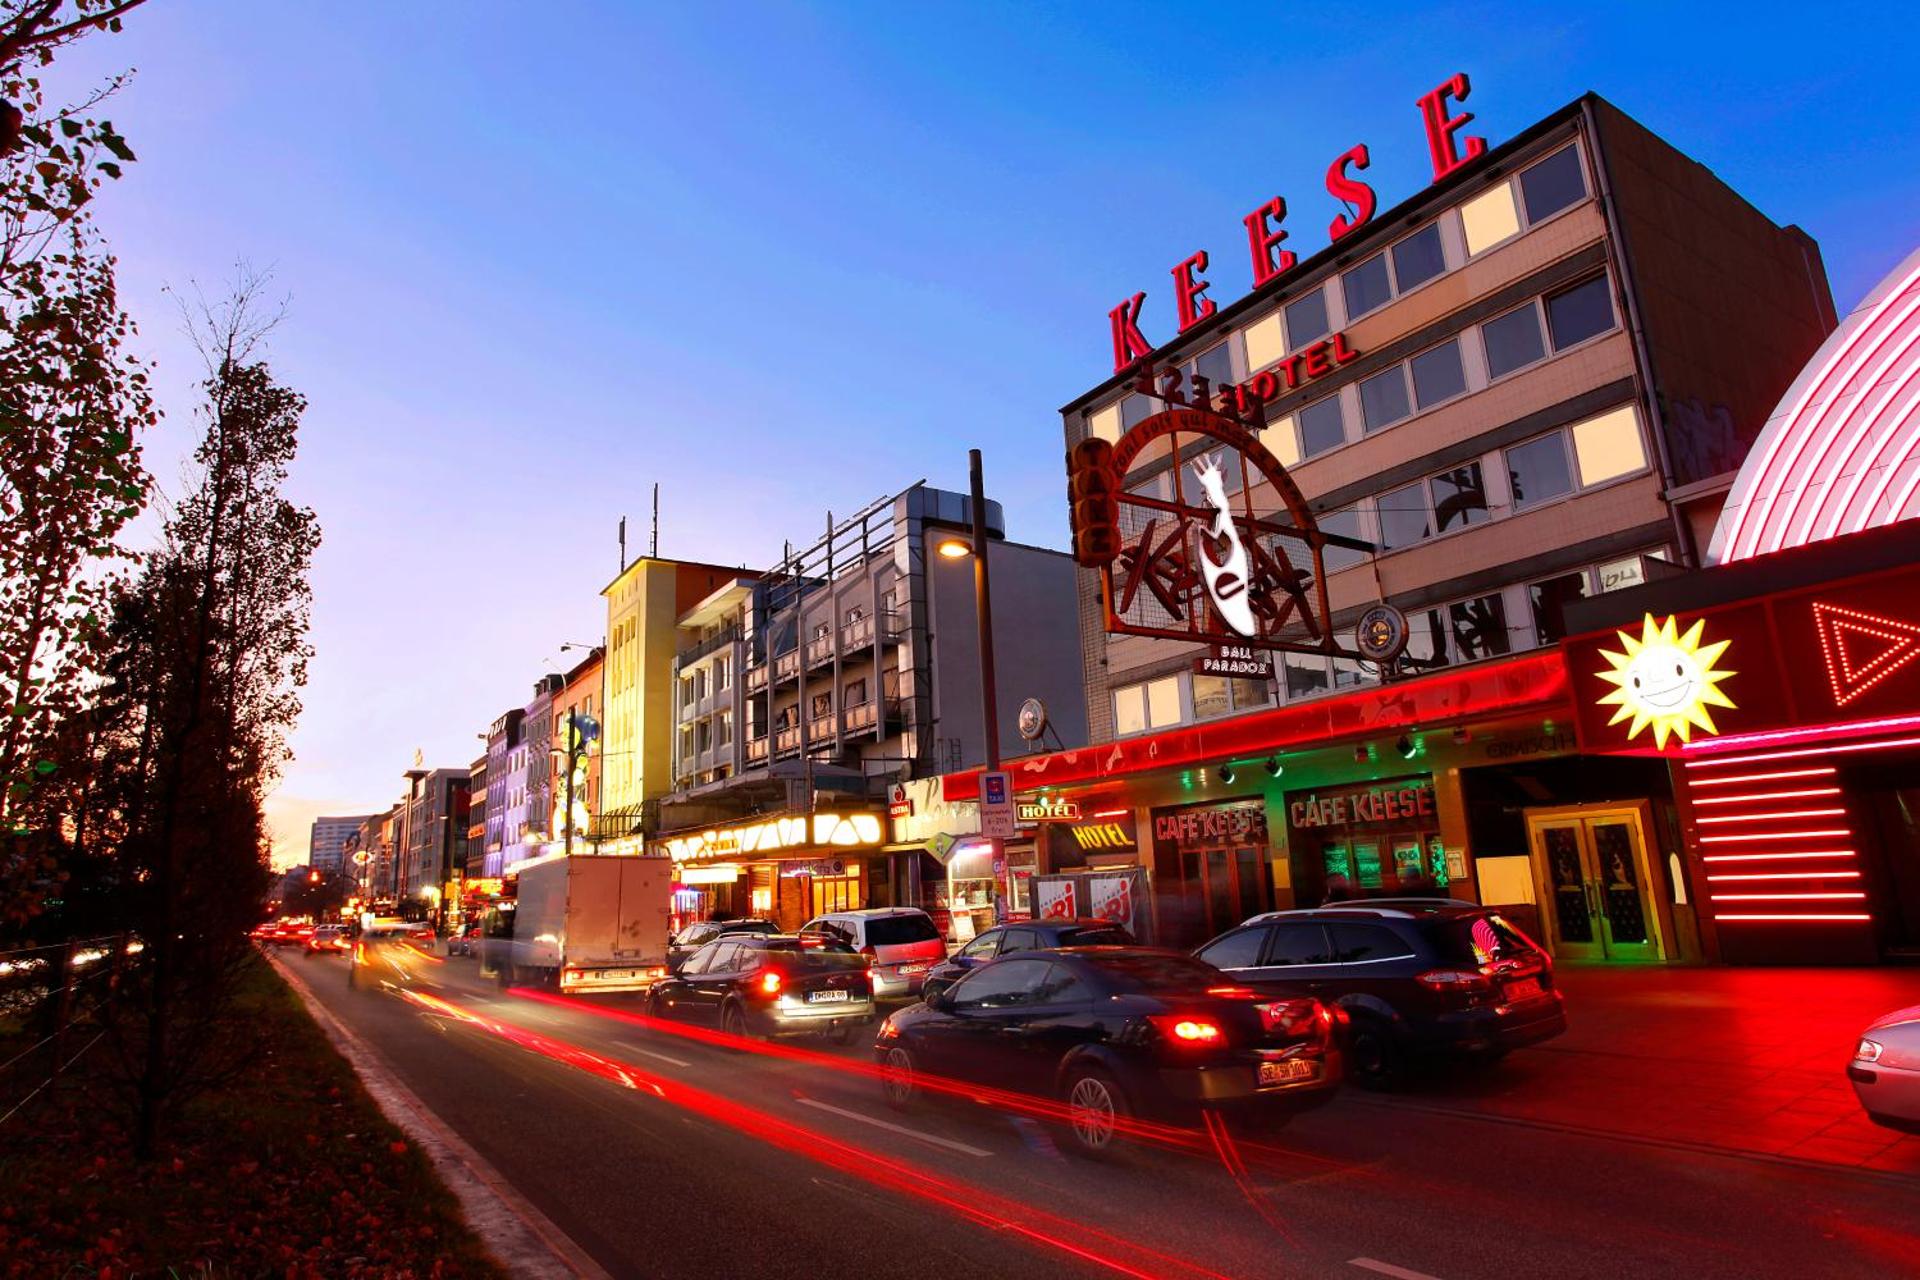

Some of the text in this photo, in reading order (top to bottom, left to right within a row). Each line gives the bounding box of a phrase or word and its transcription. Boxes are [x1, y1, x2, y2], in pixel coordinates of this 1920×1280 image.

[1108, 72, 1489, 376] KEESE
[1203, 658, 1268, 674] PARADOX
[1220, 645, 1253, 659] BALL
[1022, 804, 1073, 818] HOTEL
[1348, 787, 1433, 824] KEESE
[1071, 822, 1136, 850] HOTEL
[1200, 808, 1263, 838] KEESE
